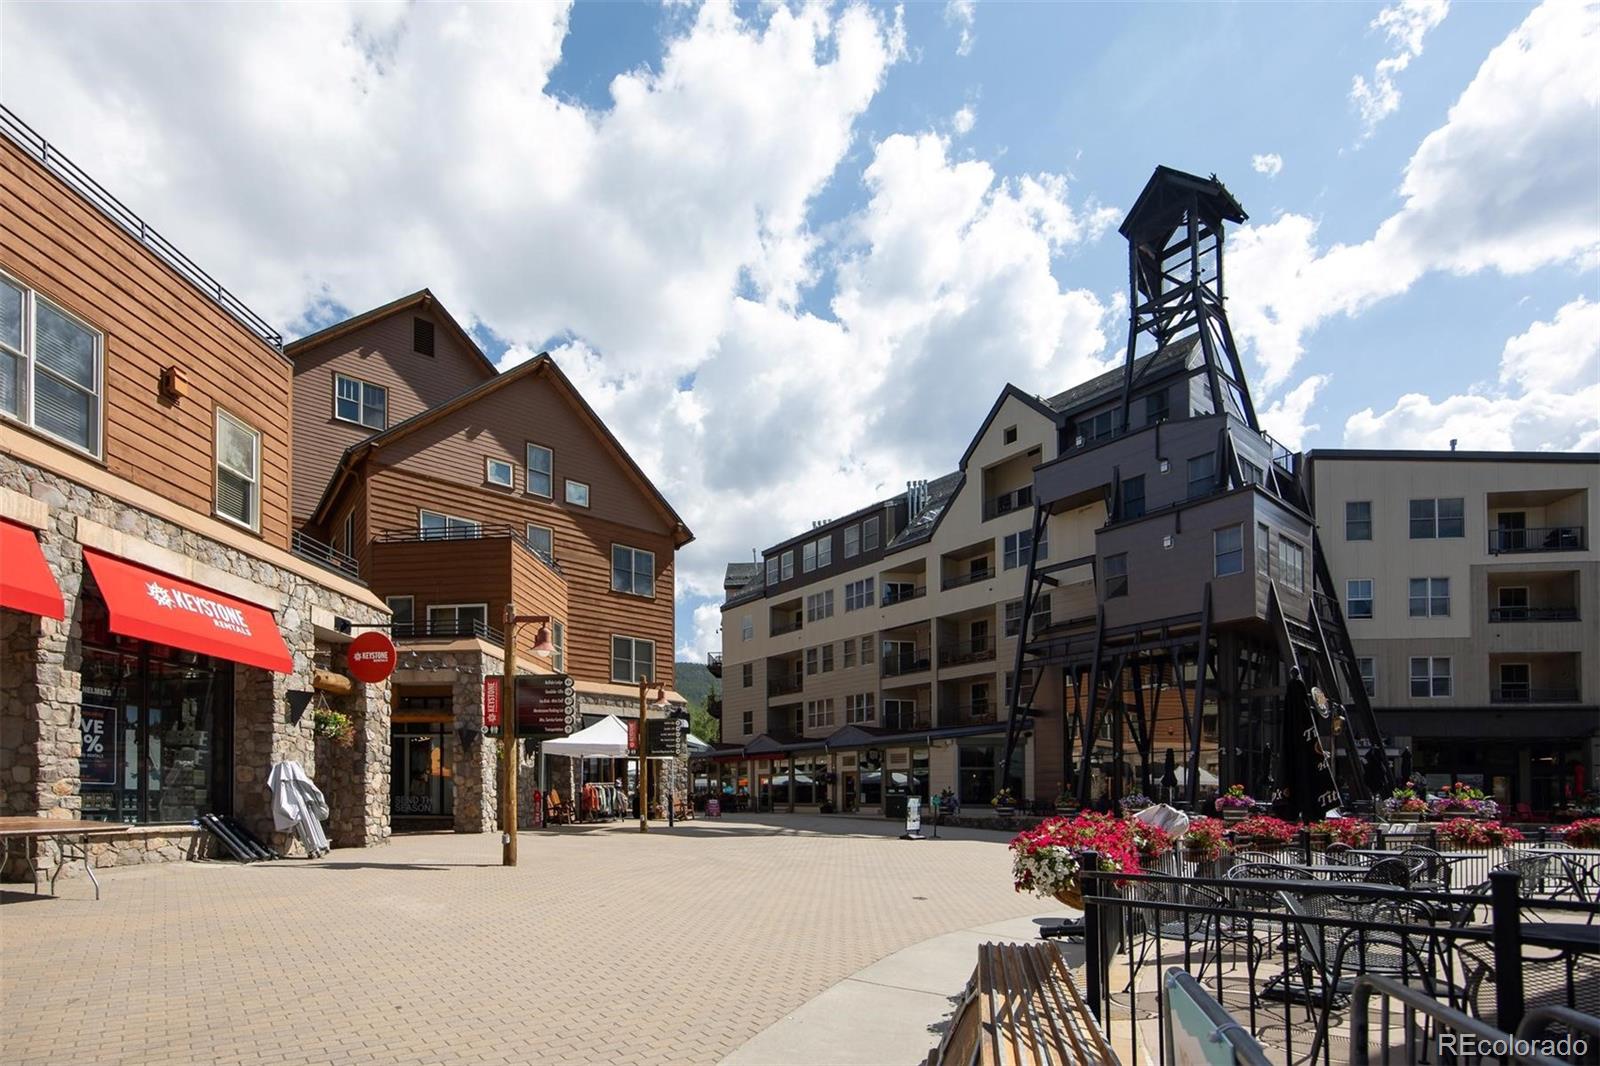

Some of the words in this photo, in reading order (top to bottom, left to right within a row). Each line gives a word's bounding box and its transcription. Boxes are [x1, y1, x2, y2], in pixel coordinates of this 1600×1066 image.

[171, 588, 248, 628] KEYSTONE
[213, 618, 252, 637] RENTALS
[362, 651, 389, 660] KEYSTONE
[82, 686, 112, 697] HELMETS
[487, 681, 496, 712] KEYSTONE
[80, 718, 104, 735] VE
